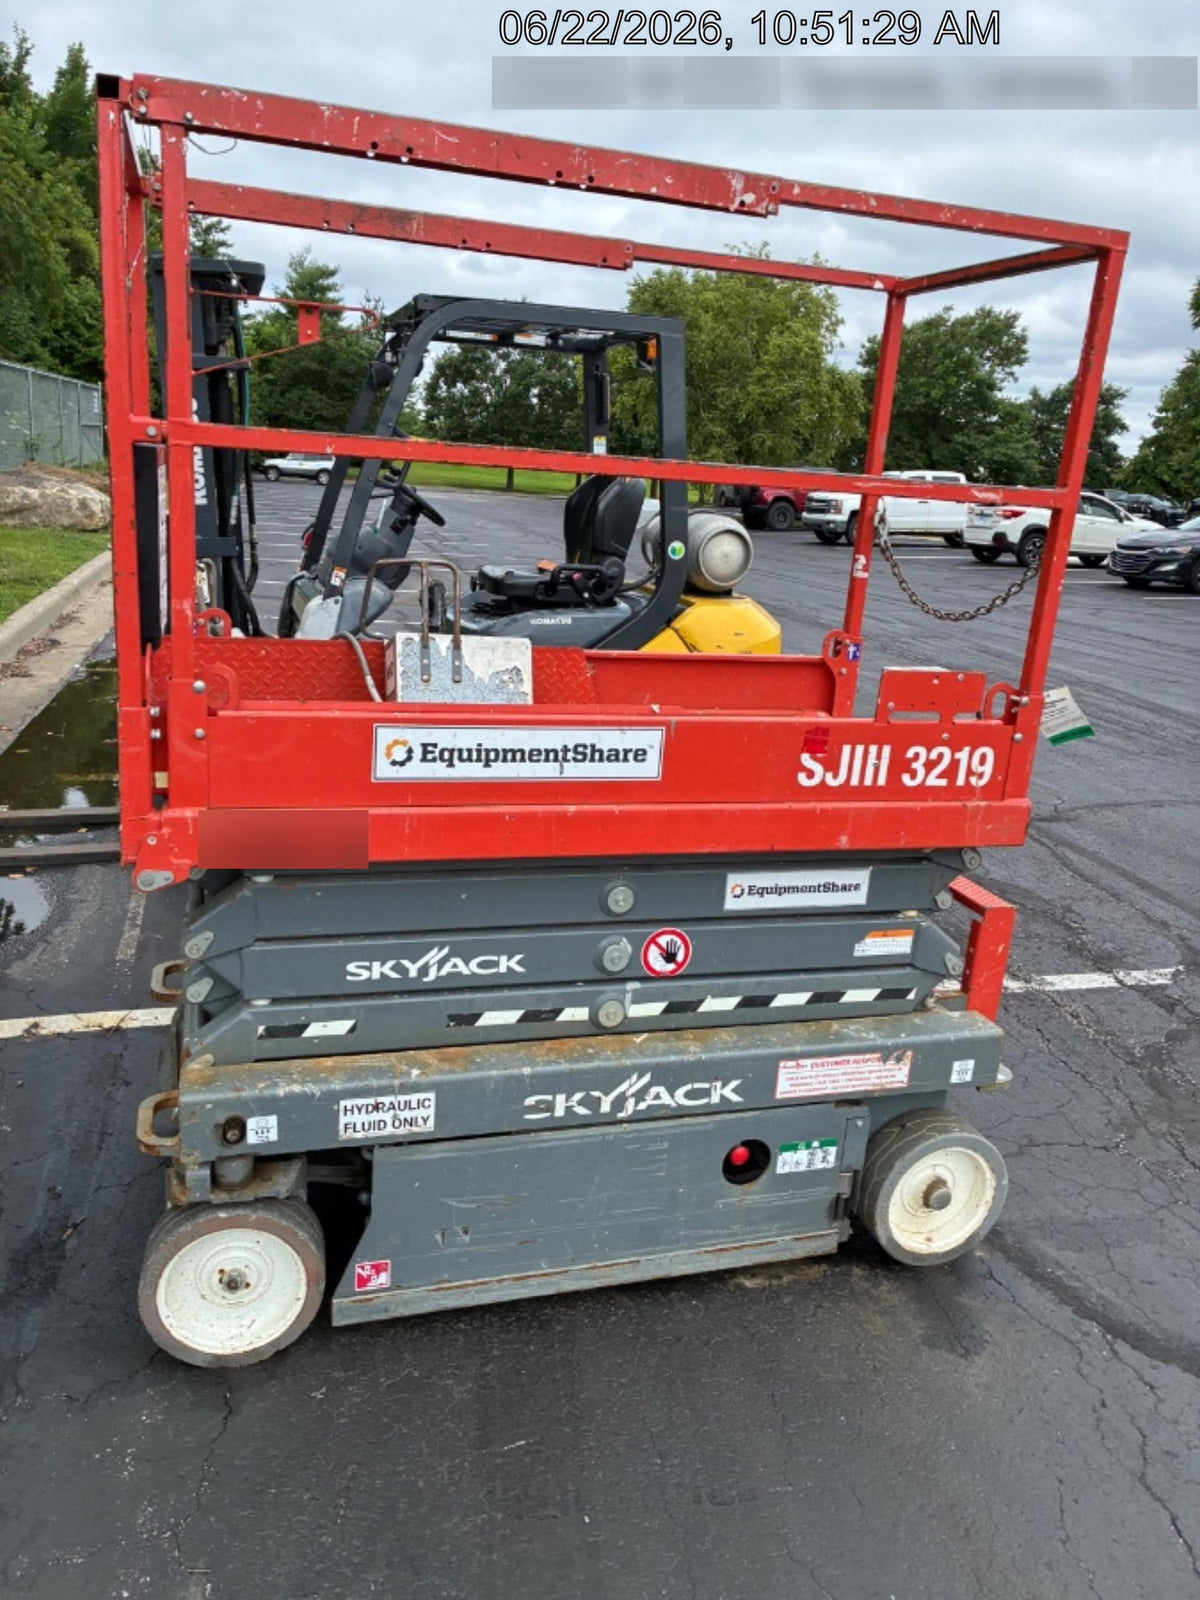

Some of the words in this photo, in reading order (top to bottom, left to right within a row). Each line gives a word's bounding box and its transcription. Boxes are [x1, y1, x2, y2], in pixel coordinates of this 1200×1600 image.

[419, 742, 648, 768] EquipmentShare
[901, 746, 995, 787] 3219
[747, 882, 861, 898] EquipmentShare
[346, 945, 526, 982] SKYJACK
[343, 1097, 432, 1117] HYDRAULIC
[343, 1118, 387, 1134] FLUID
[391, 1114, 431, 1130] ONLY
